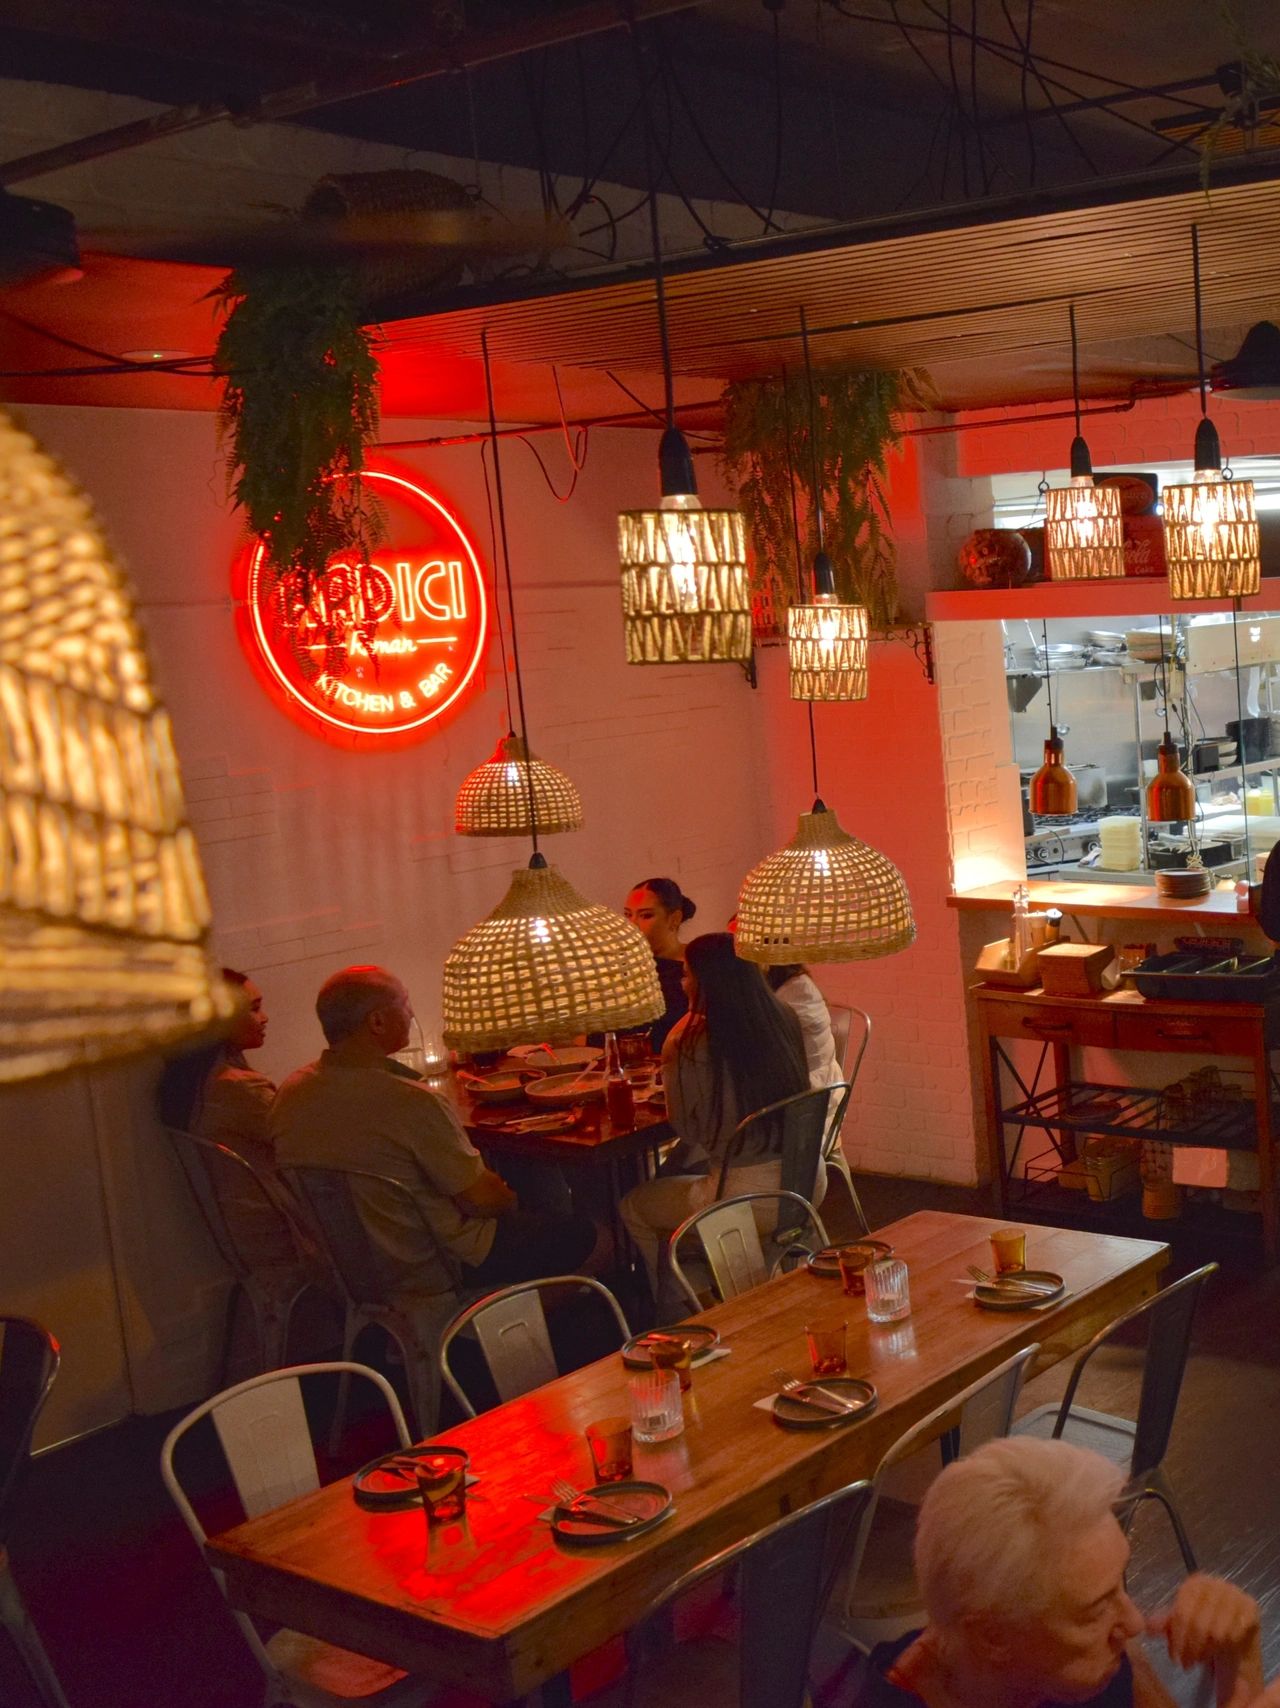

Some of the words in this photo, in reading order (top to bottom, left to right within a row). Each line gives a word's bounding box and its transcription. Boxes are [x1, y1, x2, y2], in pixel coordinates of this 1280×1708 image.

[277, 560, 467, 628] ADICI
[399, 690, 417, 710] &
[418, 661, 453, 699] BAR
